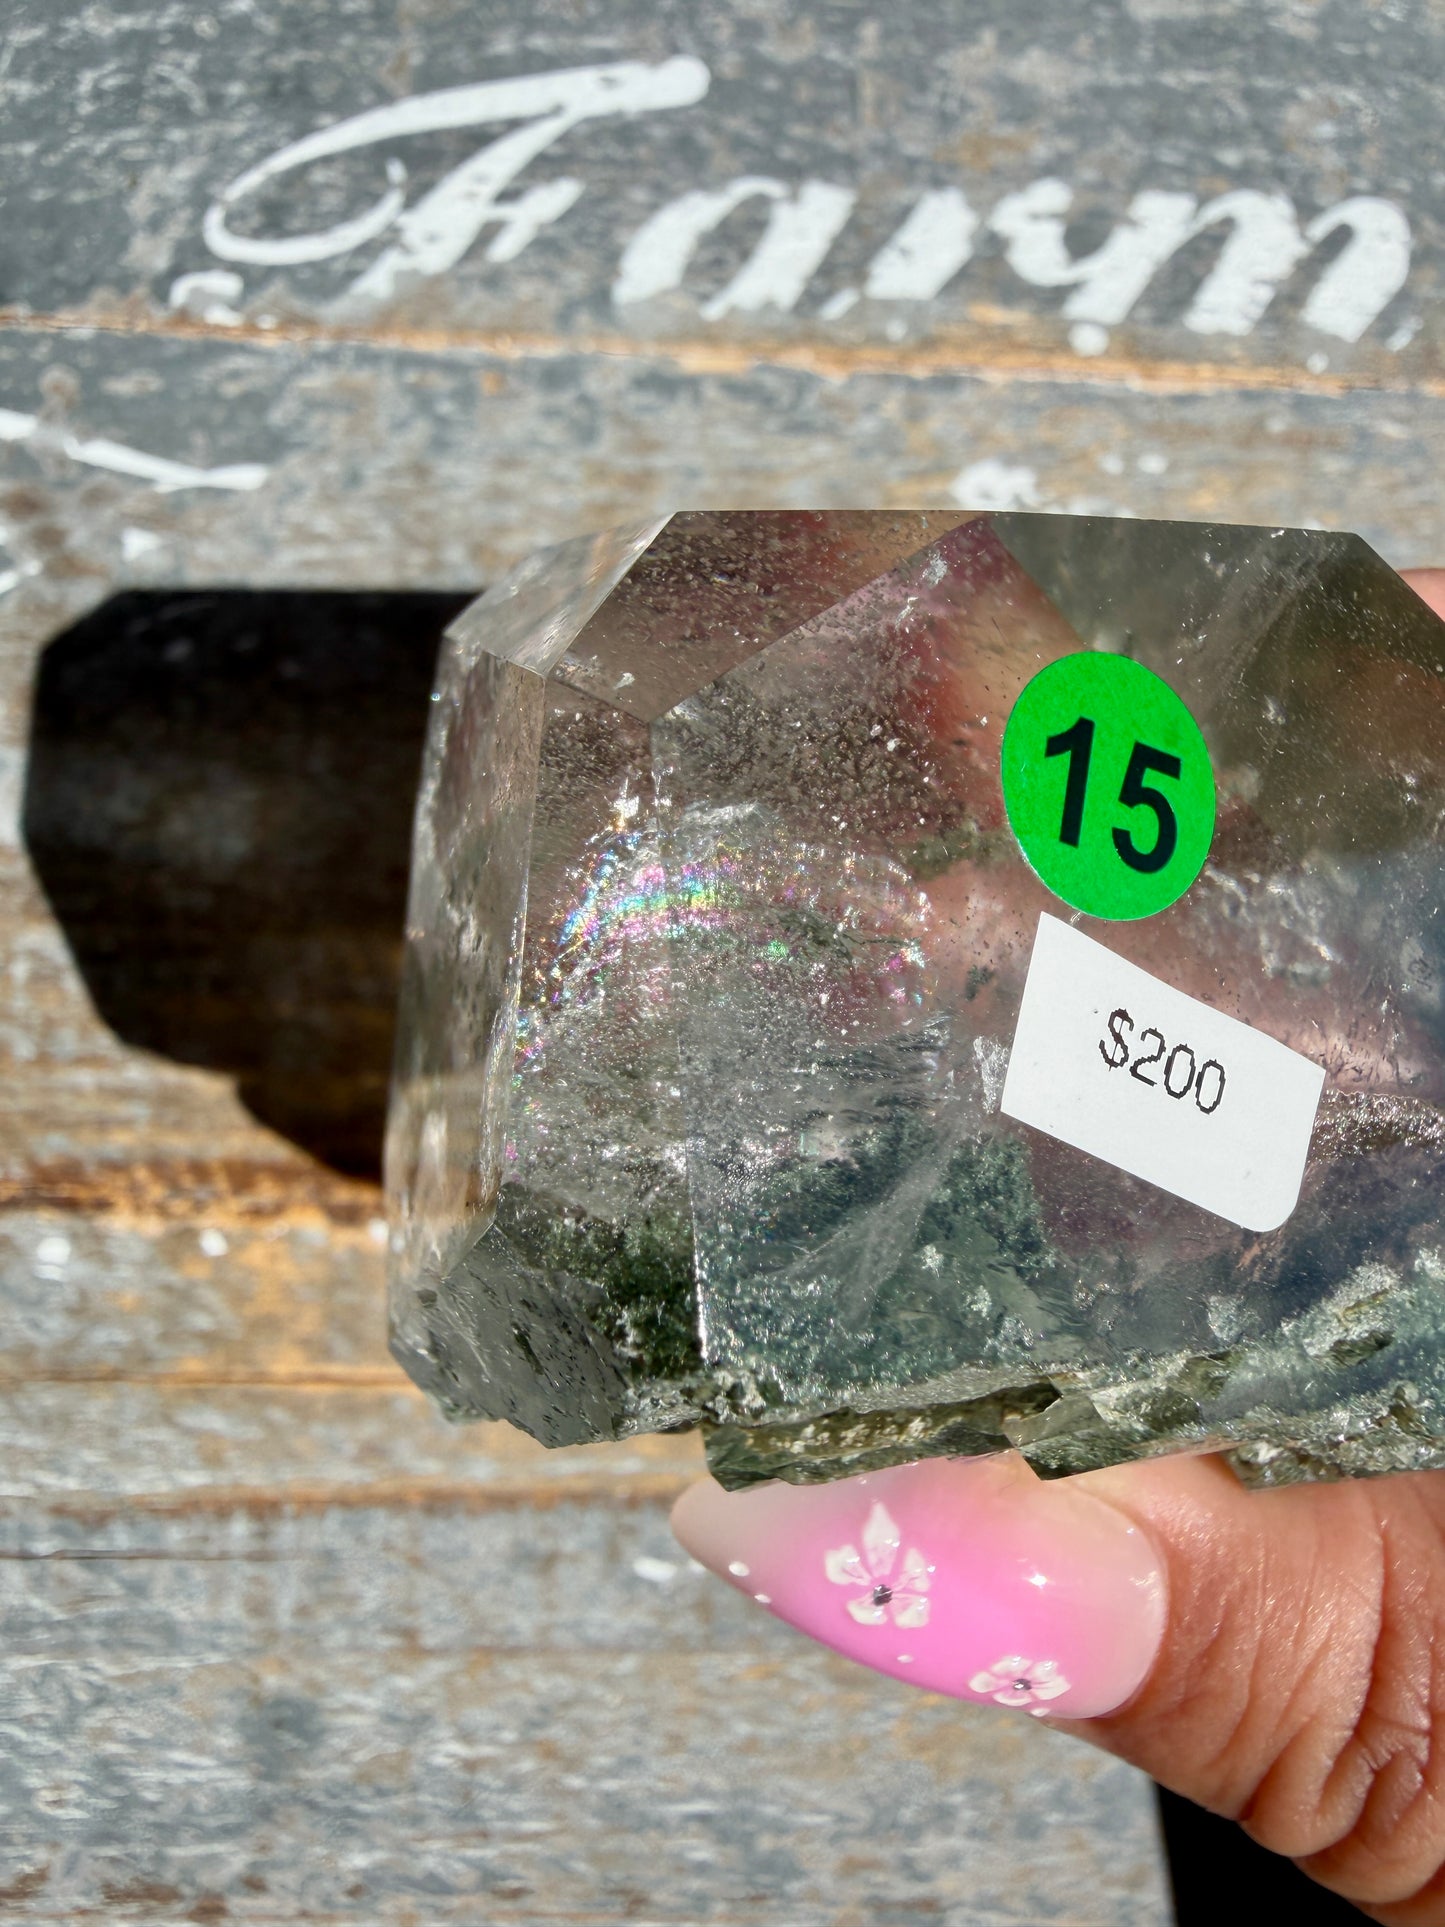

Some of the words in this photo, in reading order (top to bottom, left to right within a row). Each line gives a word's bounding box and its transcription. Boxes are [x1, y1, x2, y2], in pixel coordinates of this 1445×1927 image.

[168, 55, 1416, 350] Farm
[1045, 717, 1181, 873] 15
[1100, 1009, 1226, 1114] $200
